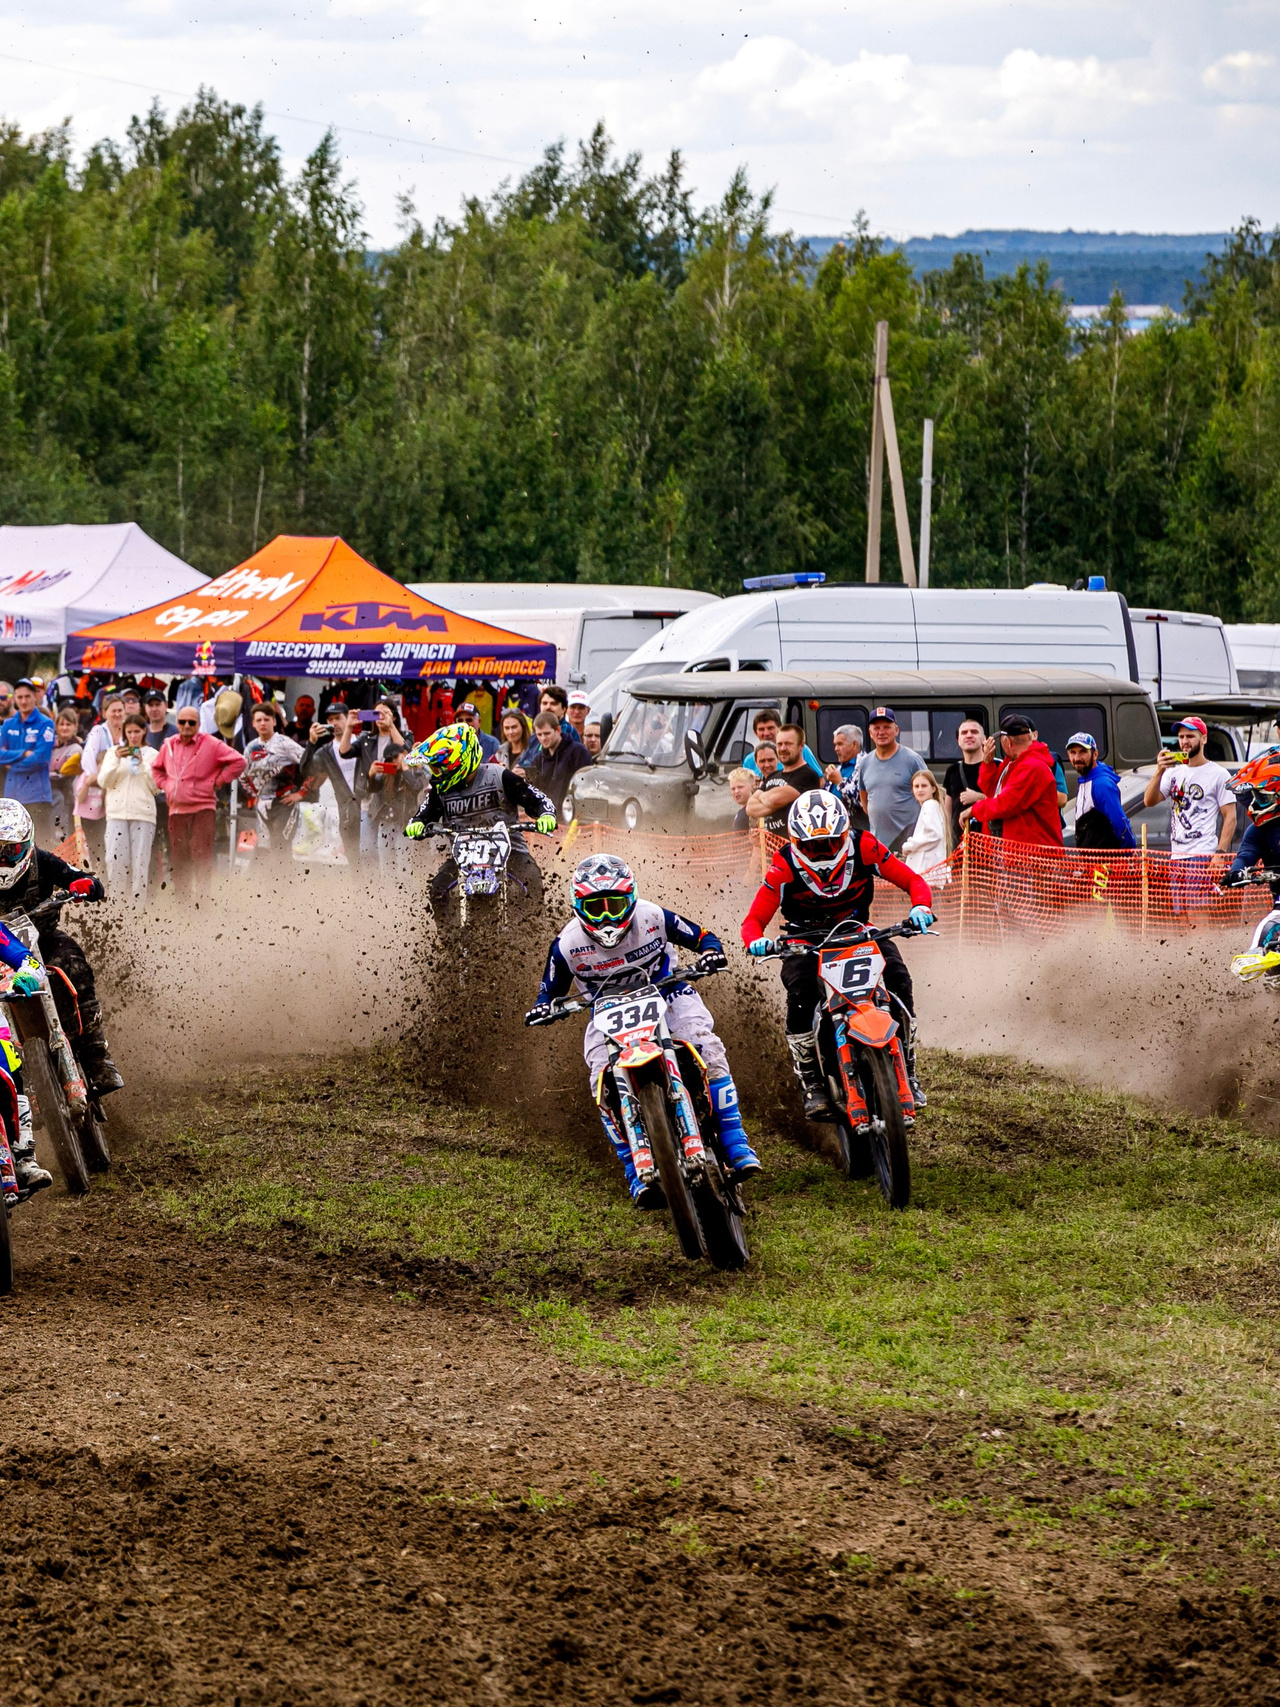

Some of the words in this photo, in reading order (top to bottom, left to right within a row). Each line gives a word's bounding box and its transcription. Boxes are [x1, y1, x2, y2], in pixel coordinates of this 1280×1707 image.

[4, 615, 32, 638] Moto
[299, 601, 449, 633] KTM
[81, 641, 116, 669] KTM
[245, 641, 346, 658] АКСЕССУАРЫ
[380, 642, 457, 660] ЗАПЧАСТИ
[304, 659, 403, 676] ЭКИПИРОВКА
[419, 659, 452, 678] для
[446, 798, 471, 816] TROY
[472, 792, 491, 811] LEE
[768, 819, 786, 830] LIVE
[570, 945, 596, 954] PARTS
[633, 939, 661, 957] YAMAH
[842, 957, 872, 988] 6
[607, 1001, 660, 1035] 334
[623, 1030, 651, 1044] KTM
